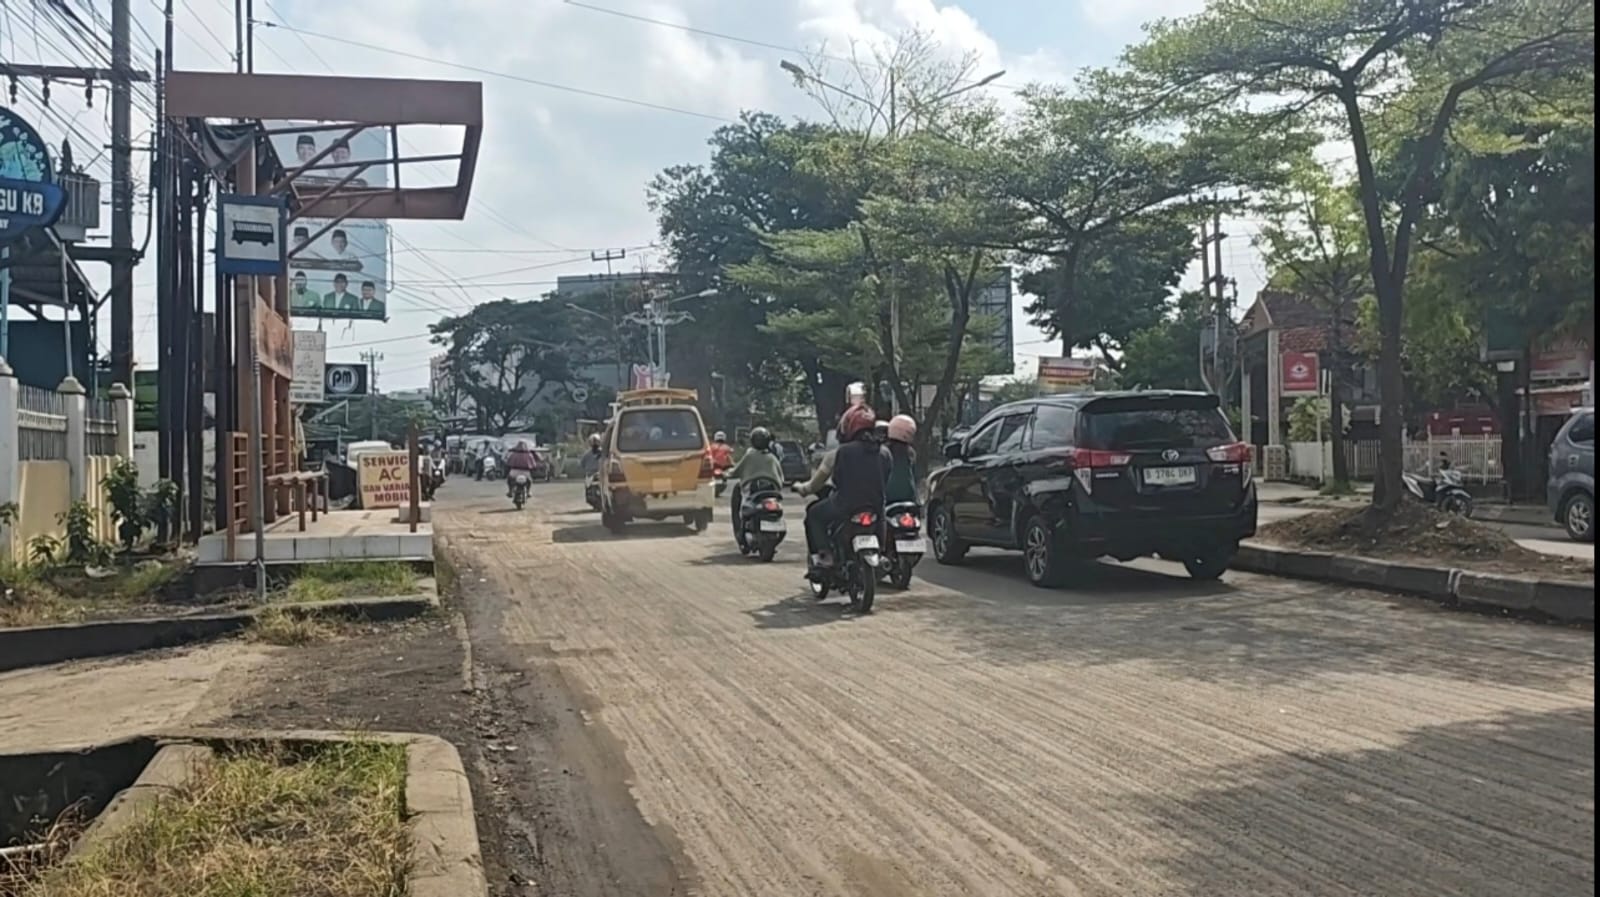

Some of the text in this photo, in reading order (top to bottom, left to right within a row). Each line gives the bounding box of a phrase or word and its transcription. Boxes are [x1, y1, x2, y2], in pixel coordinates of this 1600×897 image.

[363, 455, 409, 467] SERVIC
[379, 466, 402, 482] AC
[374, 492, 409, 502] MOBIL
